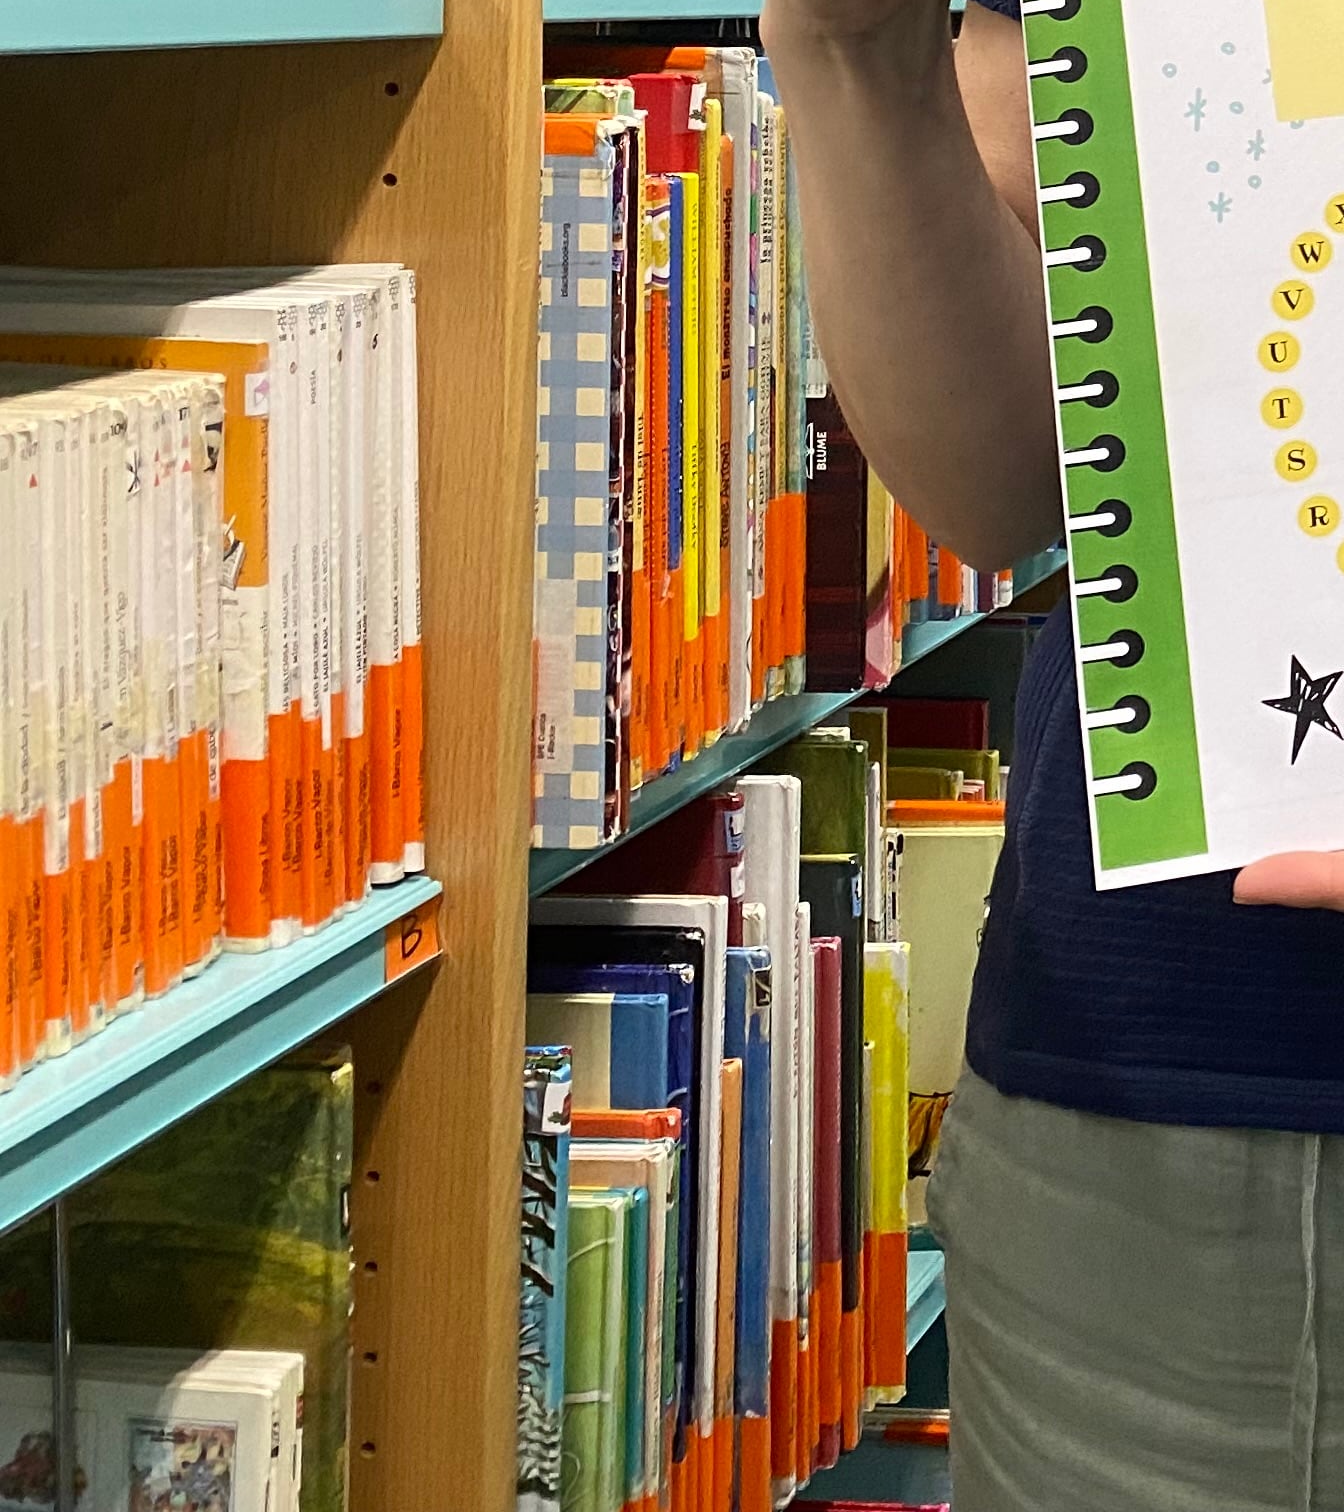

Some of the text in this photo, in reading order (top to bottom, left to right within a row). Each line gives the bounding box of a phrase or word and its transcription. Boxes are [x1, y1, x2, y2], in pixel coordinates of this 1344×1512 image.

[558, 223, 572, 297] blackiebooks.org
[1297, 240, 1324, 264] W
[722, 188, 732, 380] El monstruo encapuchado
[1279, 289, 1303, 311] V
[1268, 340, 1287, 364] U
[309, 370, 317, 405] POESÍA
[1272, 397, 1290, 420] T
[815, 431, 828, 470] BLUME
[1287, 449, 1306, 471] S
[1308, 505, 1330, 528] R
[391, 708, 402, 746] Vapor
[311, 770, 323, 809] Vapor
[399, 912, 423, 959] B
